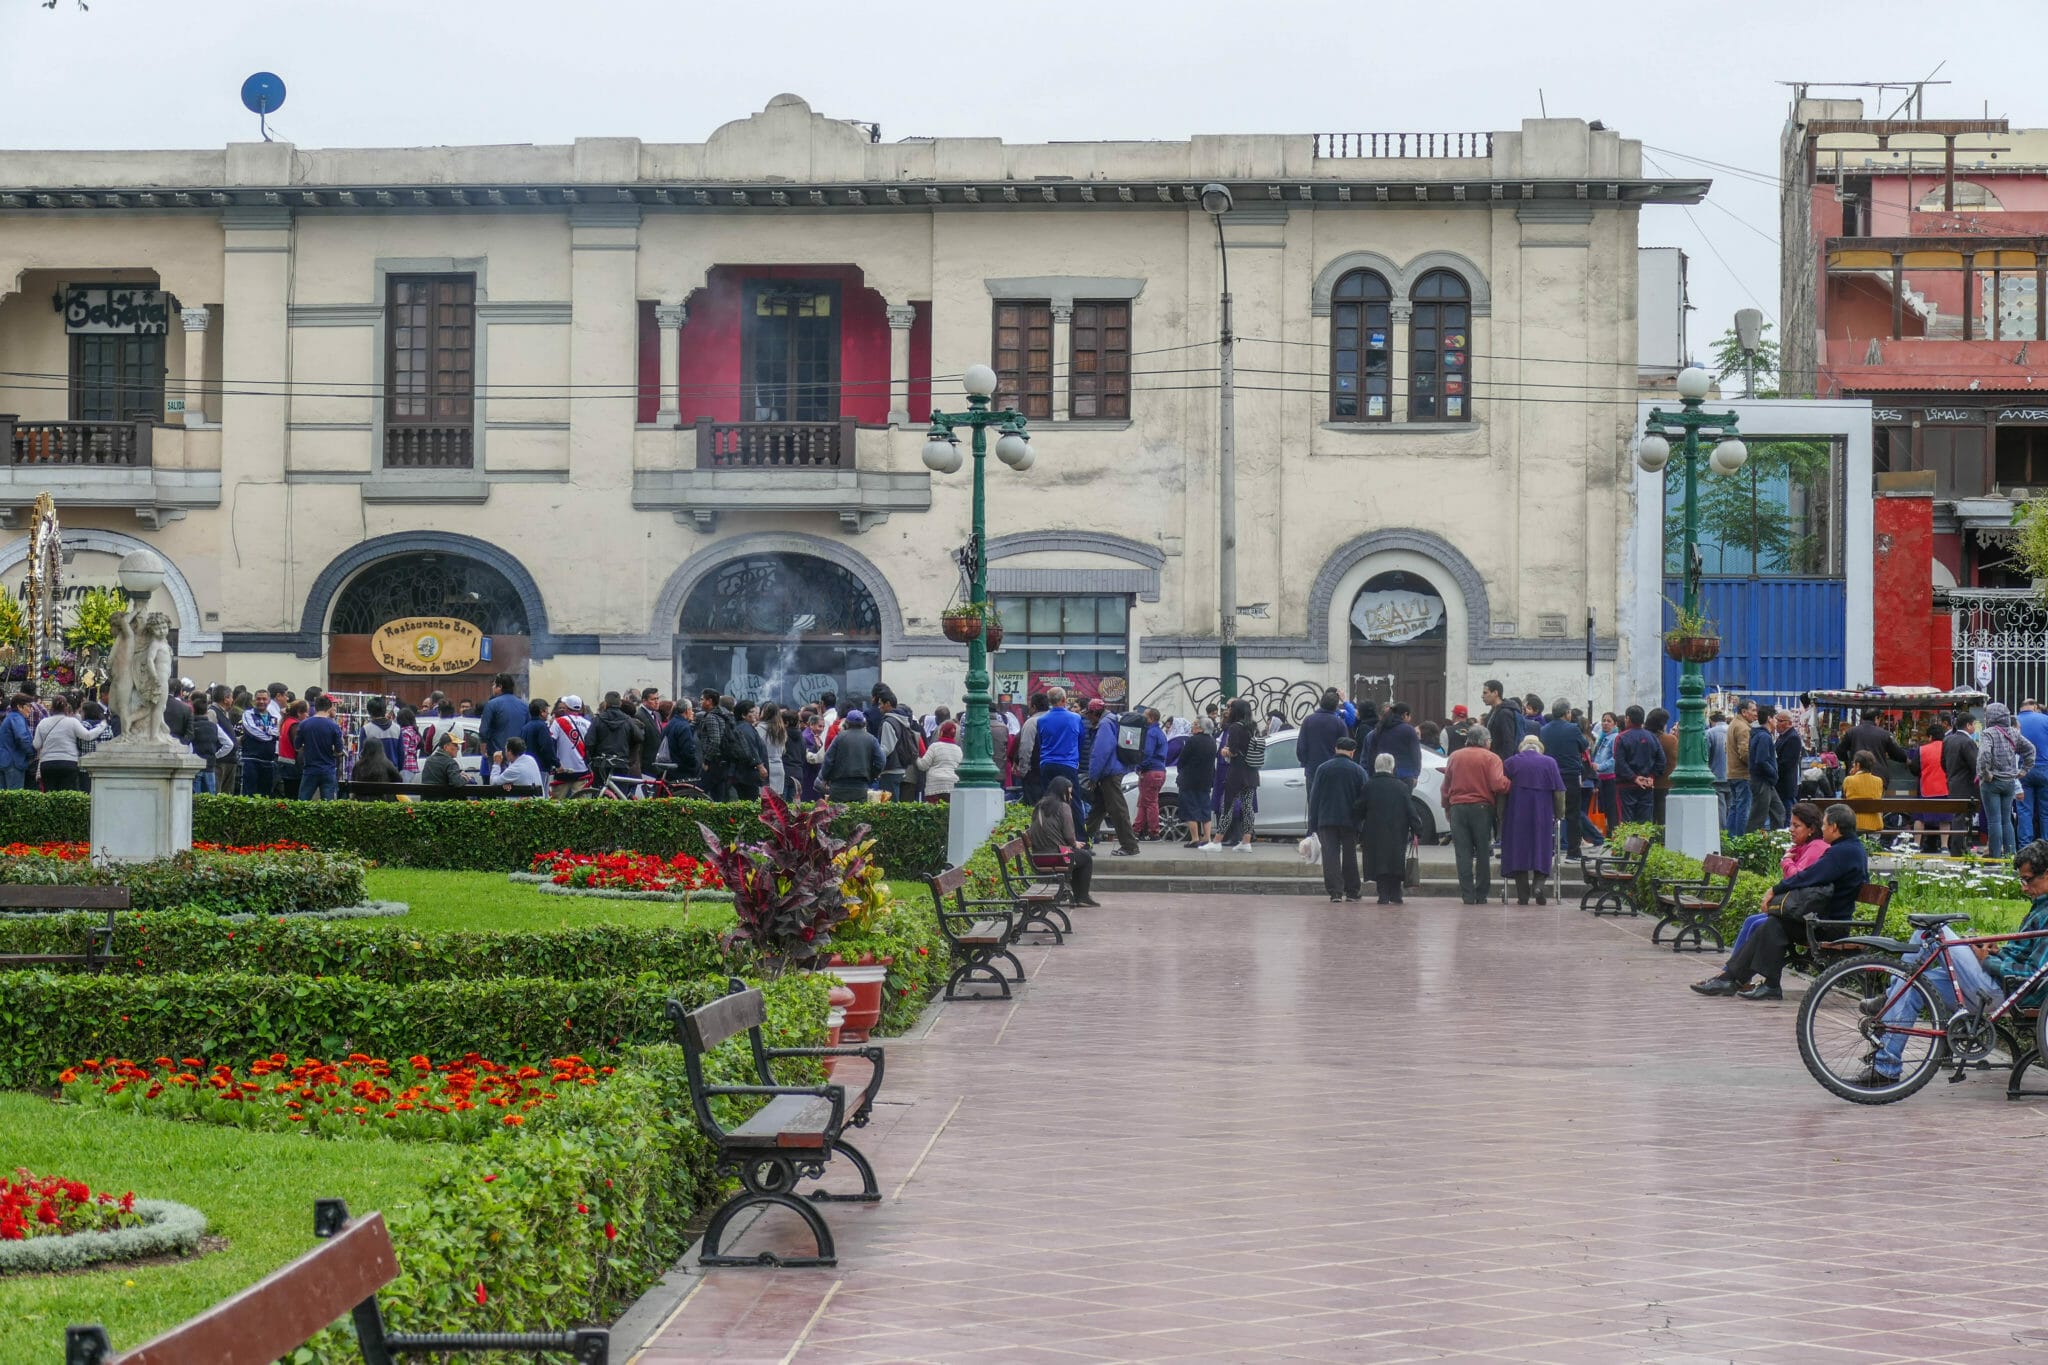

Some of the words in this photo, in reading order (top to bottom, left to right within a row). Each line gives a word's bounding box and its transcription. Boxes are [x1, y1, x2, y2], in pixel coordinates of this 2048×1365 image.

[167, 401, 185, 410] SALIDA
[384, 620, 450, 637] Restaurante
[454, 621, 473, 636] Bar
[383, 653, 394, 666] El
[430, 663, 440, 672] de
[443, 658, 474, 671] Walter
[1003, 681, 1020, 694] 31
